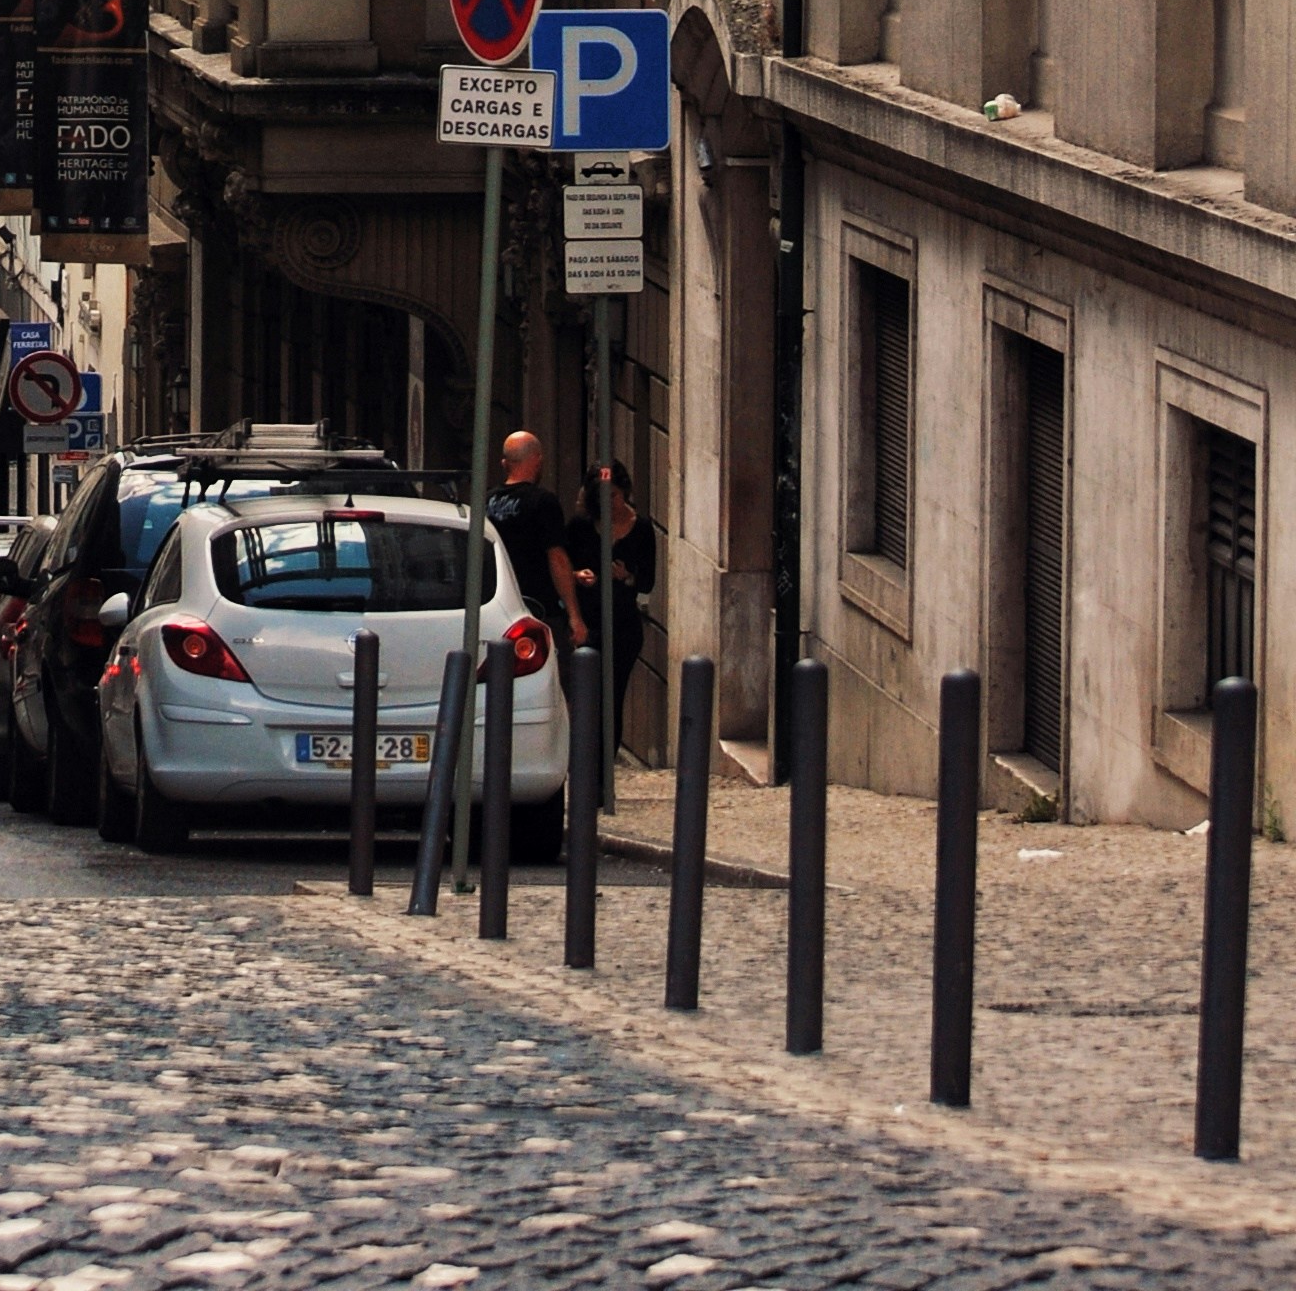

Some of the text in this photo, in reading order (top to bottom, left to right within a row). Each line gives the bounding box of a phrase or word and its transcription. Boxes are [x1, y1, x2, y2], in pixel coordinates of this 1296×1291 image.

[459, 77, 537, 94] EXCEPTO
[563, 27, 638, 136] P
[57, 106, 129, 115] HUMANIDADE
[450, 99, 543, 117] CARGAS E
[57, 125, 131, 149] FADO
[442, 120, 549, 140] DESCARGAS
[57, 159, 114, 169] HERITAGE
[57, 171, 128, 181] HUMANITY
[13, 341, 48, 349] FERREIRA
